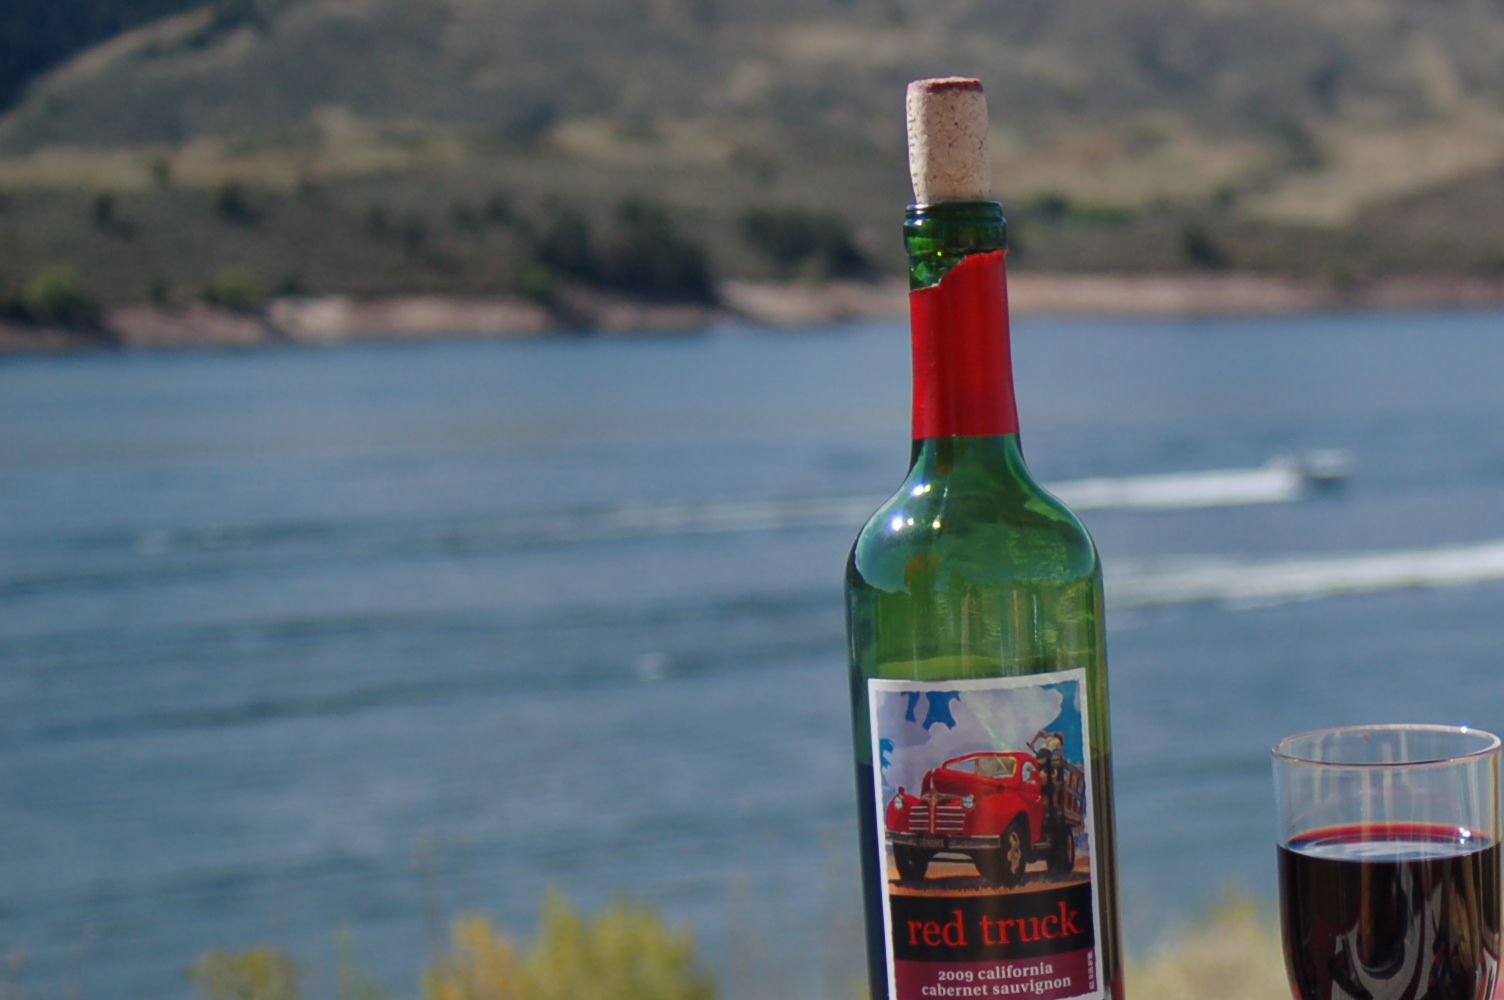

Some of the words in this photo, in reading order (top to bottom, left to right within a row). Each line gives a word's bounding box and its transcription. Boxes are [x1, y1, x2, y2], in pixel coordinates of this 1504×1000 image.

[907, 909, 968, 947] red
[978, 900, 1081, 946] truck
[938, 970, 974, 982] 2009
[977, 961, 1054, 981] california
[921, 983, 989, 997] cabernet
[993, 976, 1072, 995] sauvignon
